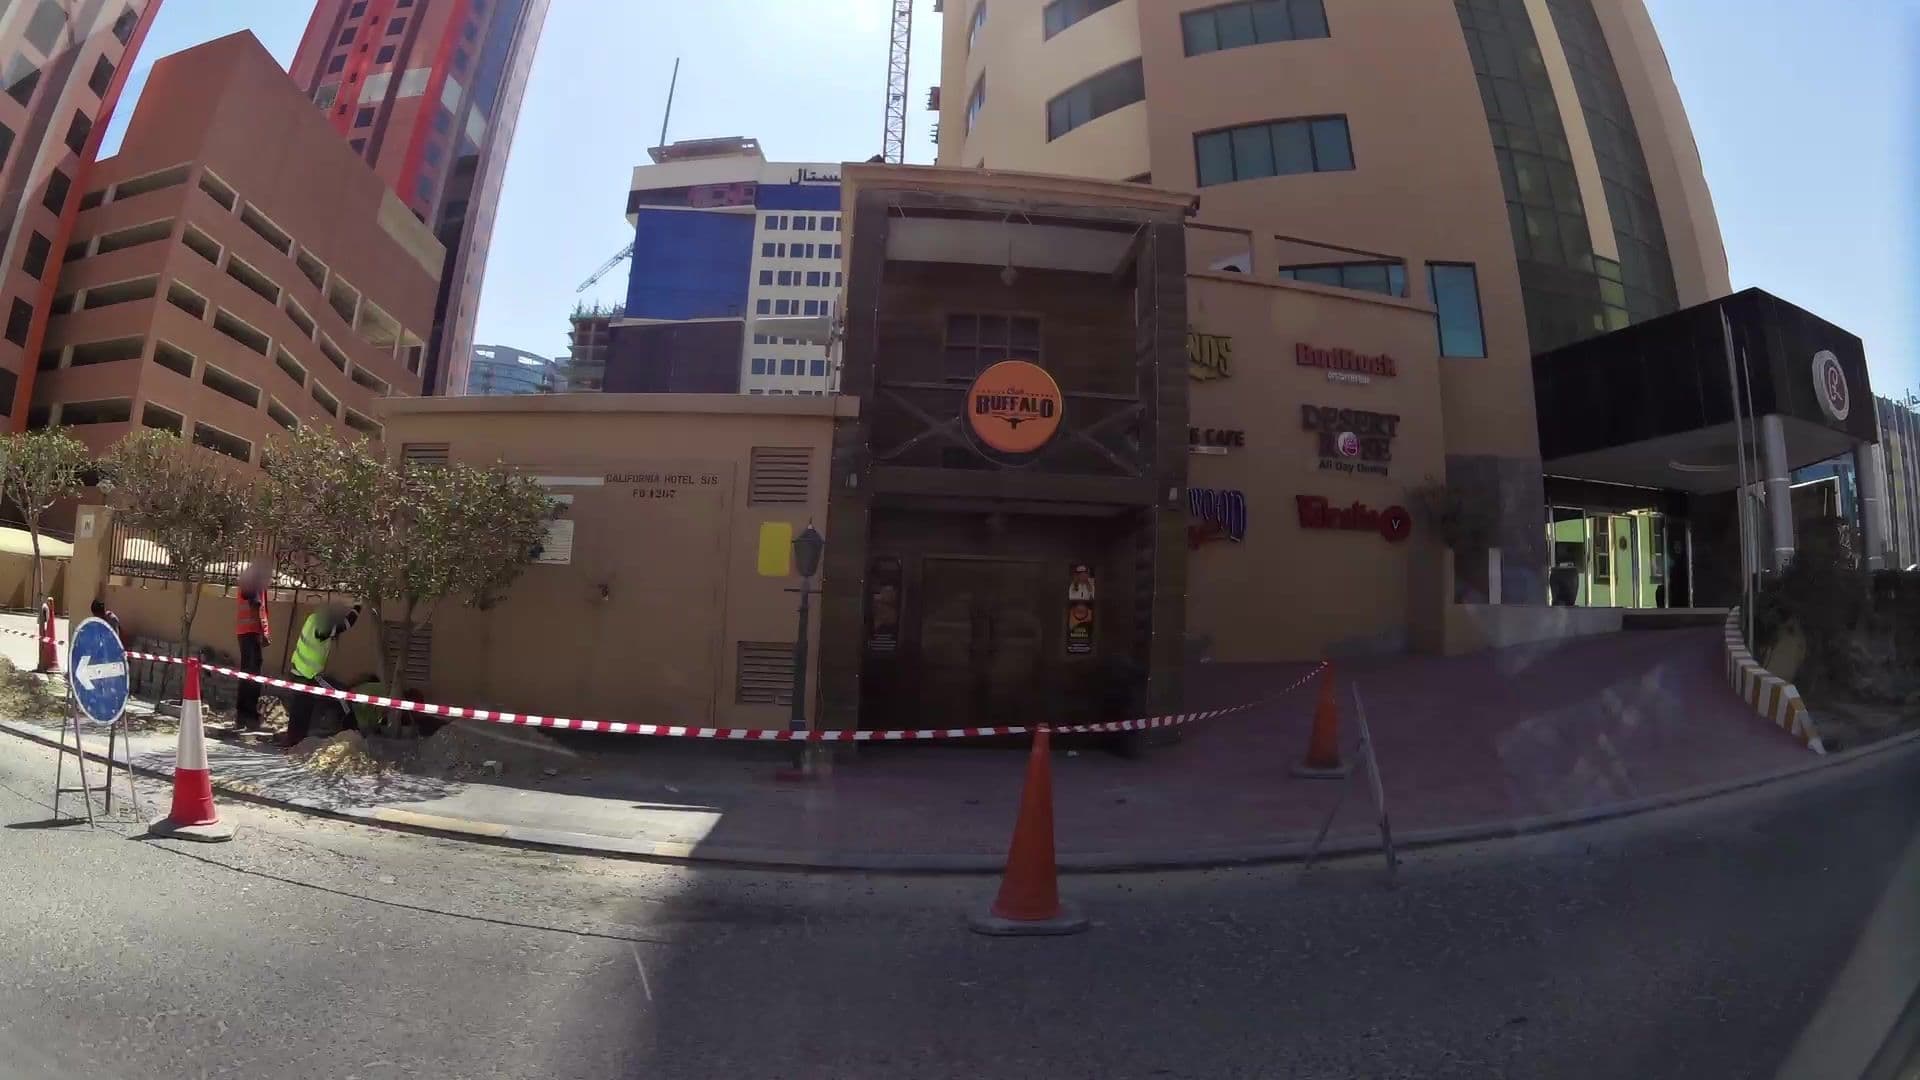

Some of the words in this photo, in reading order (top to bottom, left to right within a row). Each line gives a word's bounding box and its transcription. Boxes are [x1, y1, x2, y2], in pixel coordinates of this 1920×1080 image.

[976, 395, 1053, 417] BUFFALO
[1301, 404, 1400, 437] DESERT
[1206, 429, 1245, 446] CAFE
[1336, 461, 1354, 473] Day
[605, 473, 658, 483] CALIFORNIA
[664, 475, 695, 485] HOTEL
